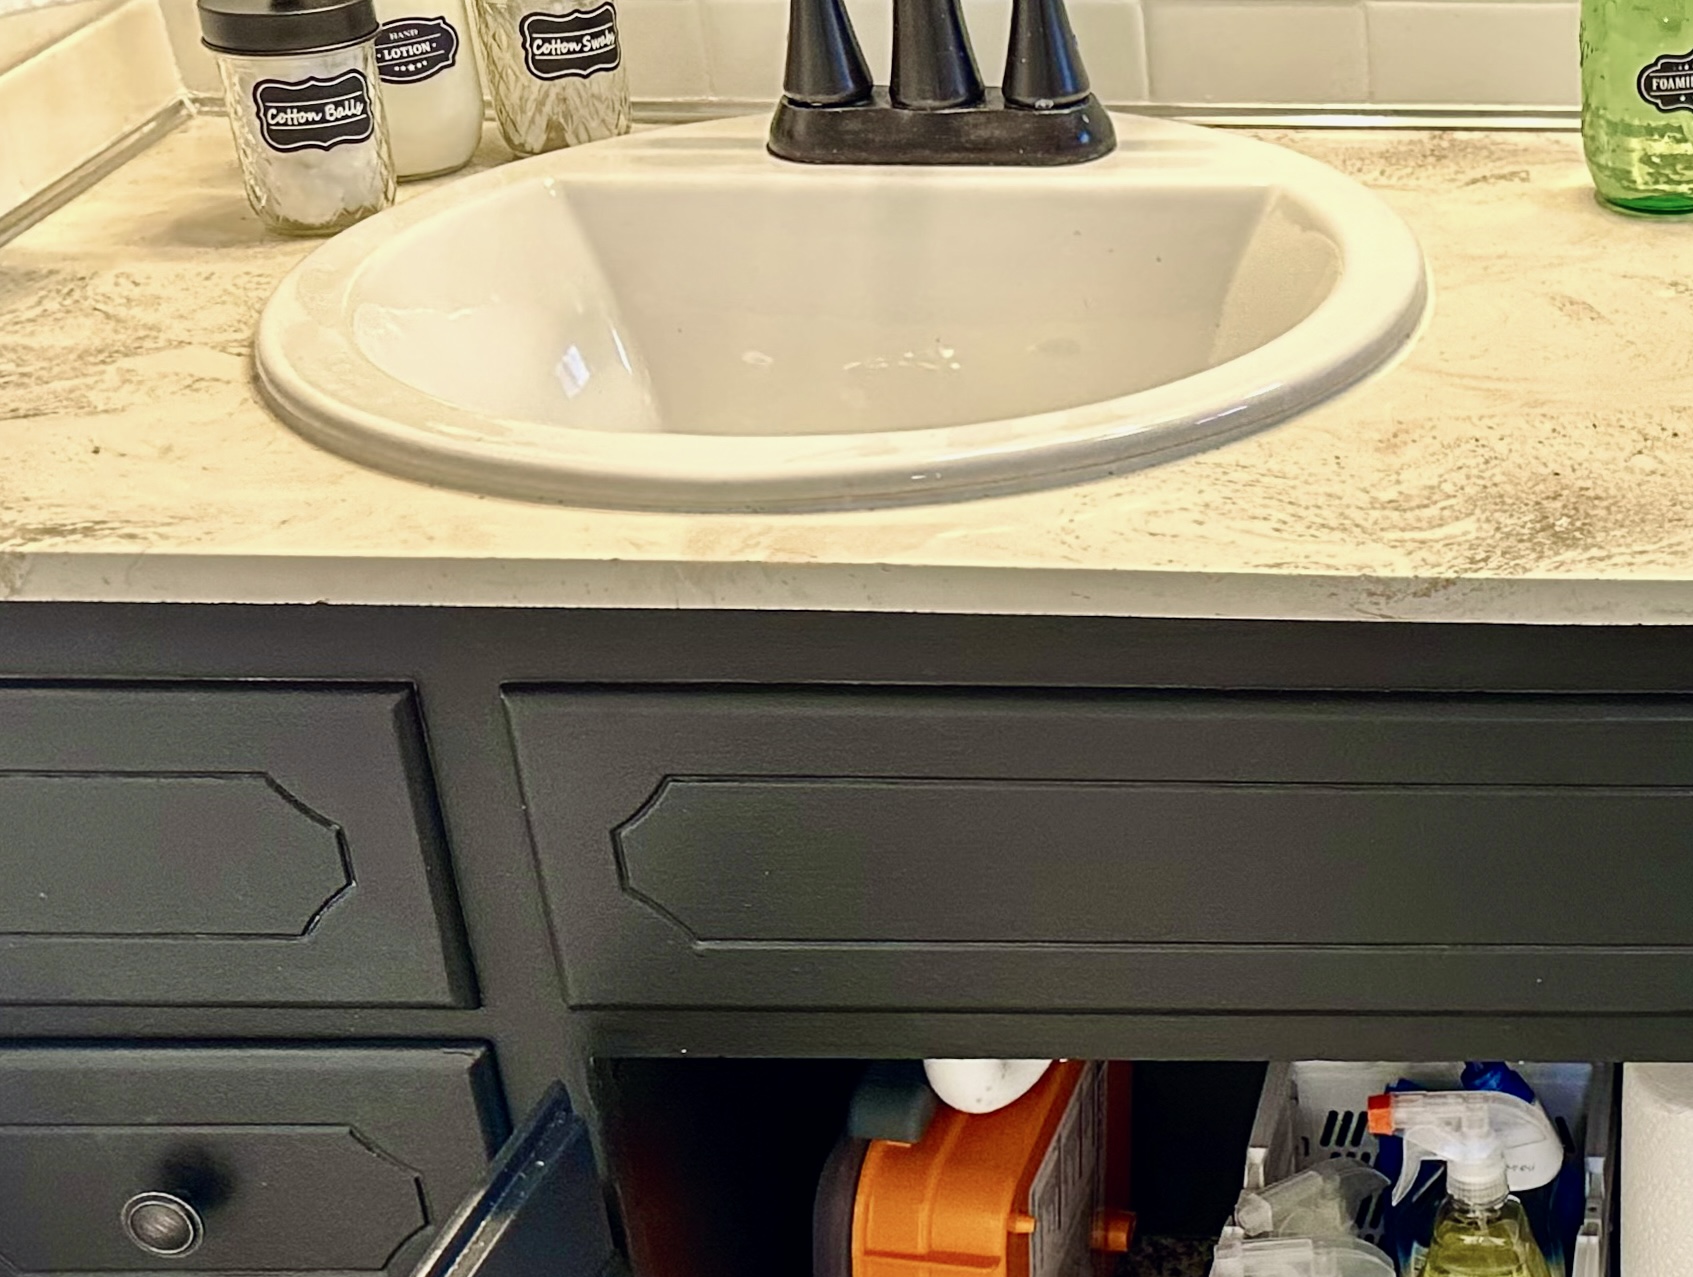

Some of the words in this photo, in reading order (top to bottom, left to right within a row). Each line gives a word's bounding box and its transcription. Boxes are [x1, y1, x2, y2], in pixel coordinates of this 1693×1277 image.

[389, 28, 419, 41] HAND
[533, 38, 582, 55] Cotton
[582, 29, 615, 51] Swabs
[383, 41, 431, 60] LOTION
[267, 108, 322, 125] Cotton
[324, 99, 364, 121] Balls
